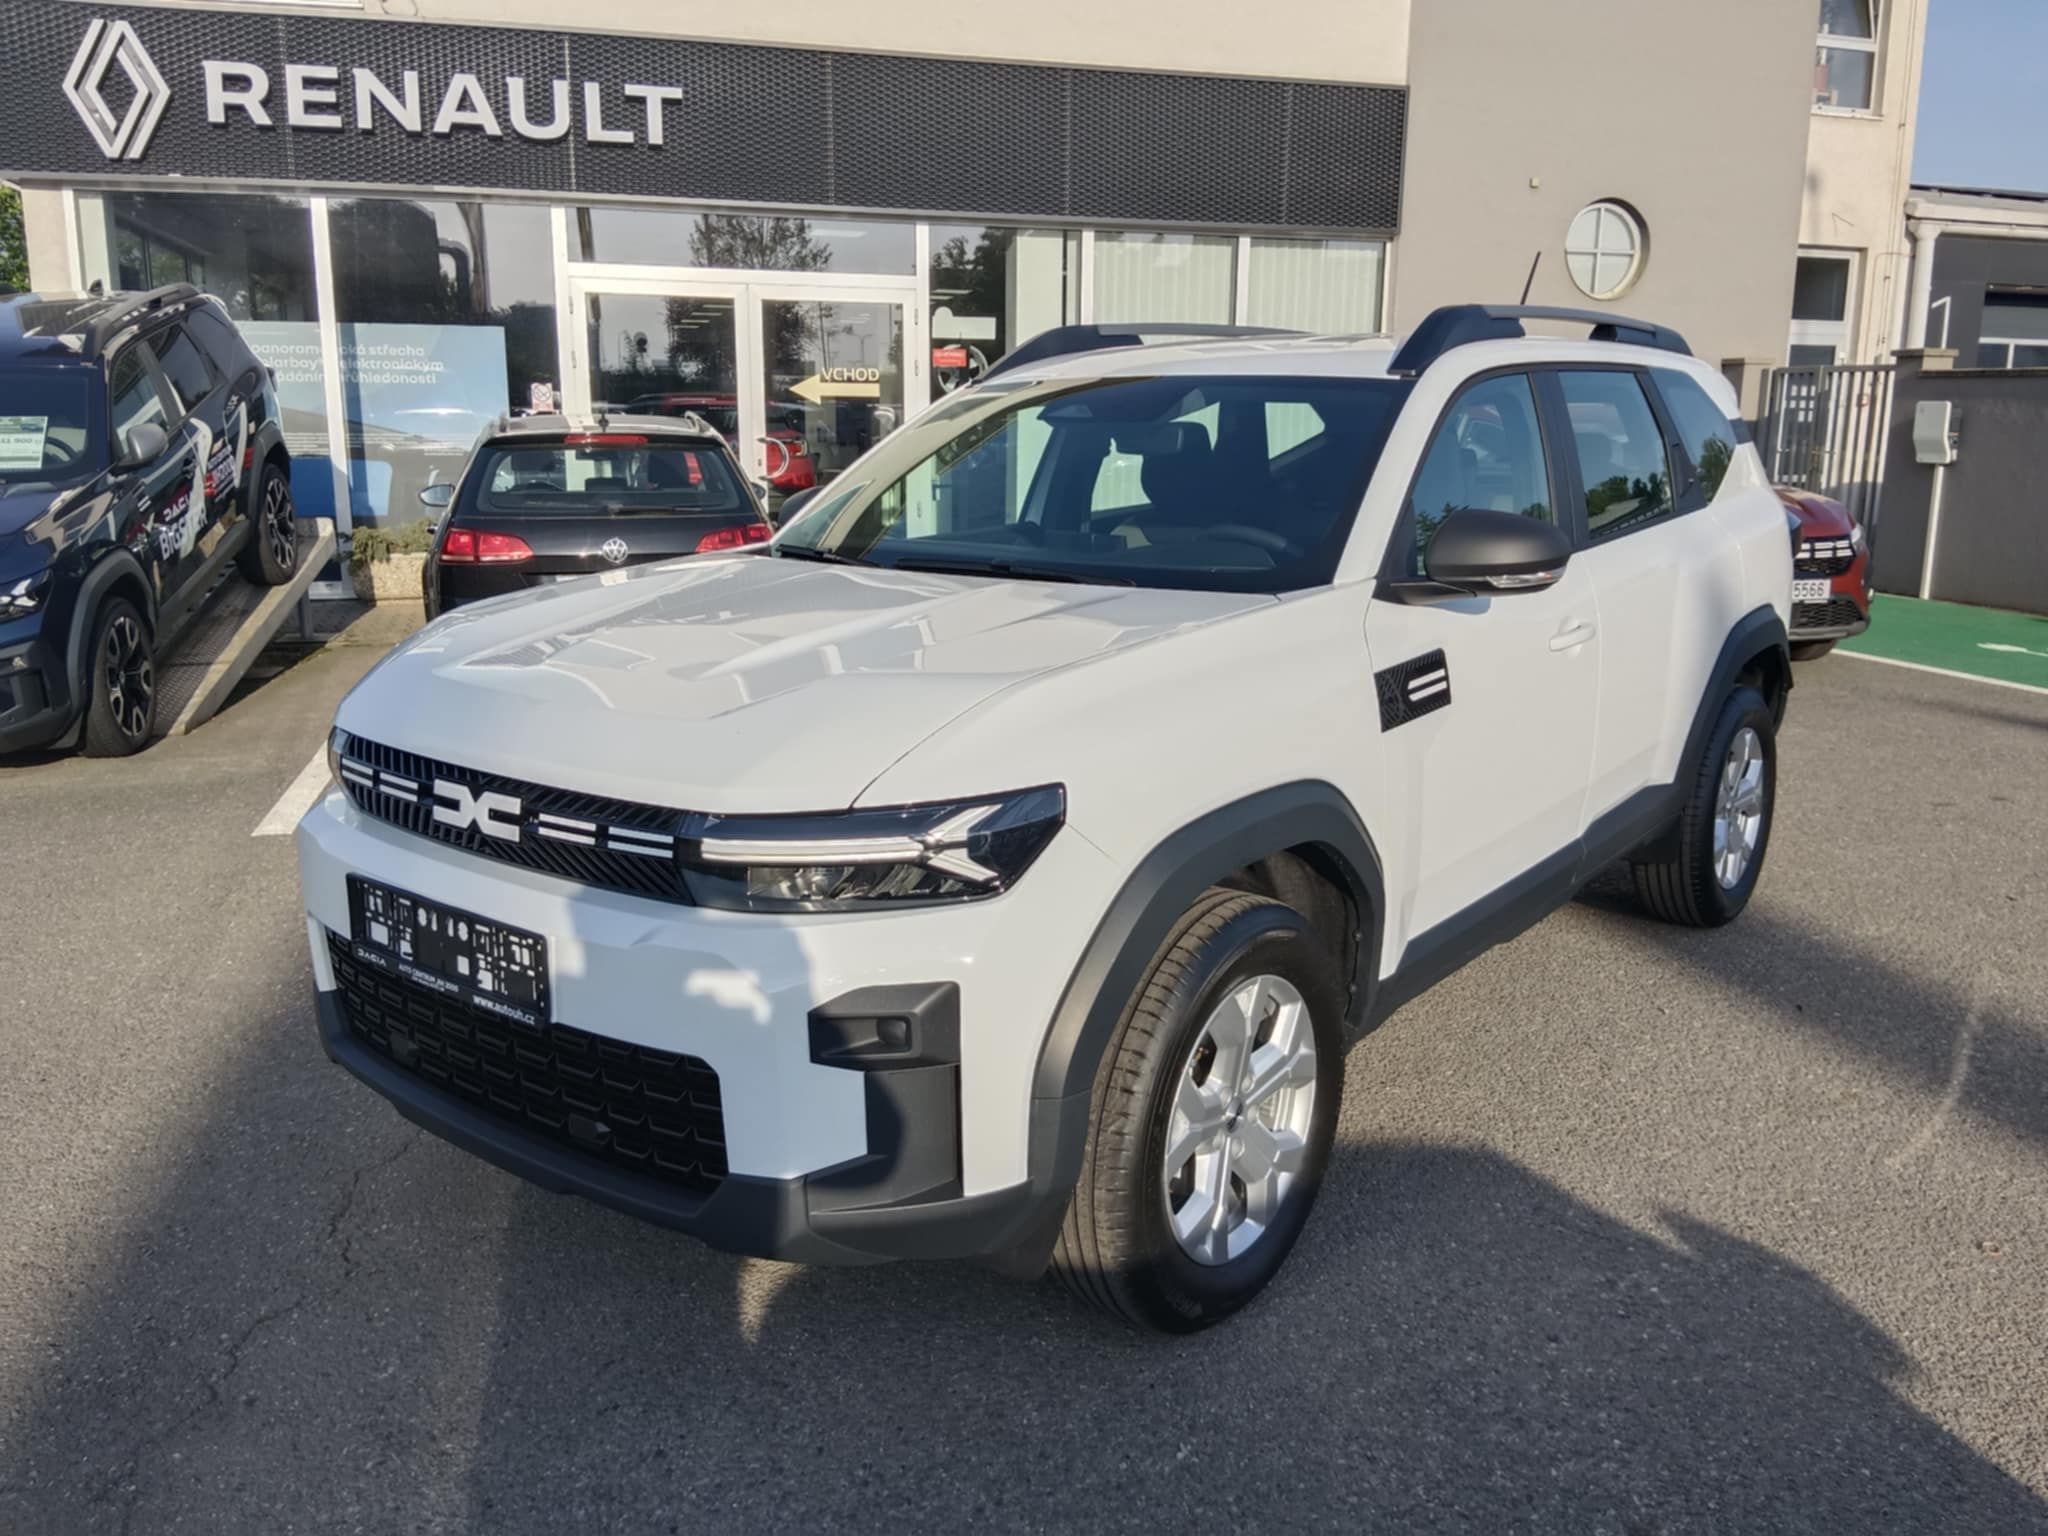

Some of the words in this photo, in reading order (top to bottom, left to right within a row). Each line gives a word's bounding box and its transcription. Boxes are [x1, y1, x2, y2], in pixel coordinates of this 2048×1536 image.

[202, 60, 683, 145] RENAULT
[821, 367, 880, 382] VCHOD
[357, 947, 387, 967] DACIA
